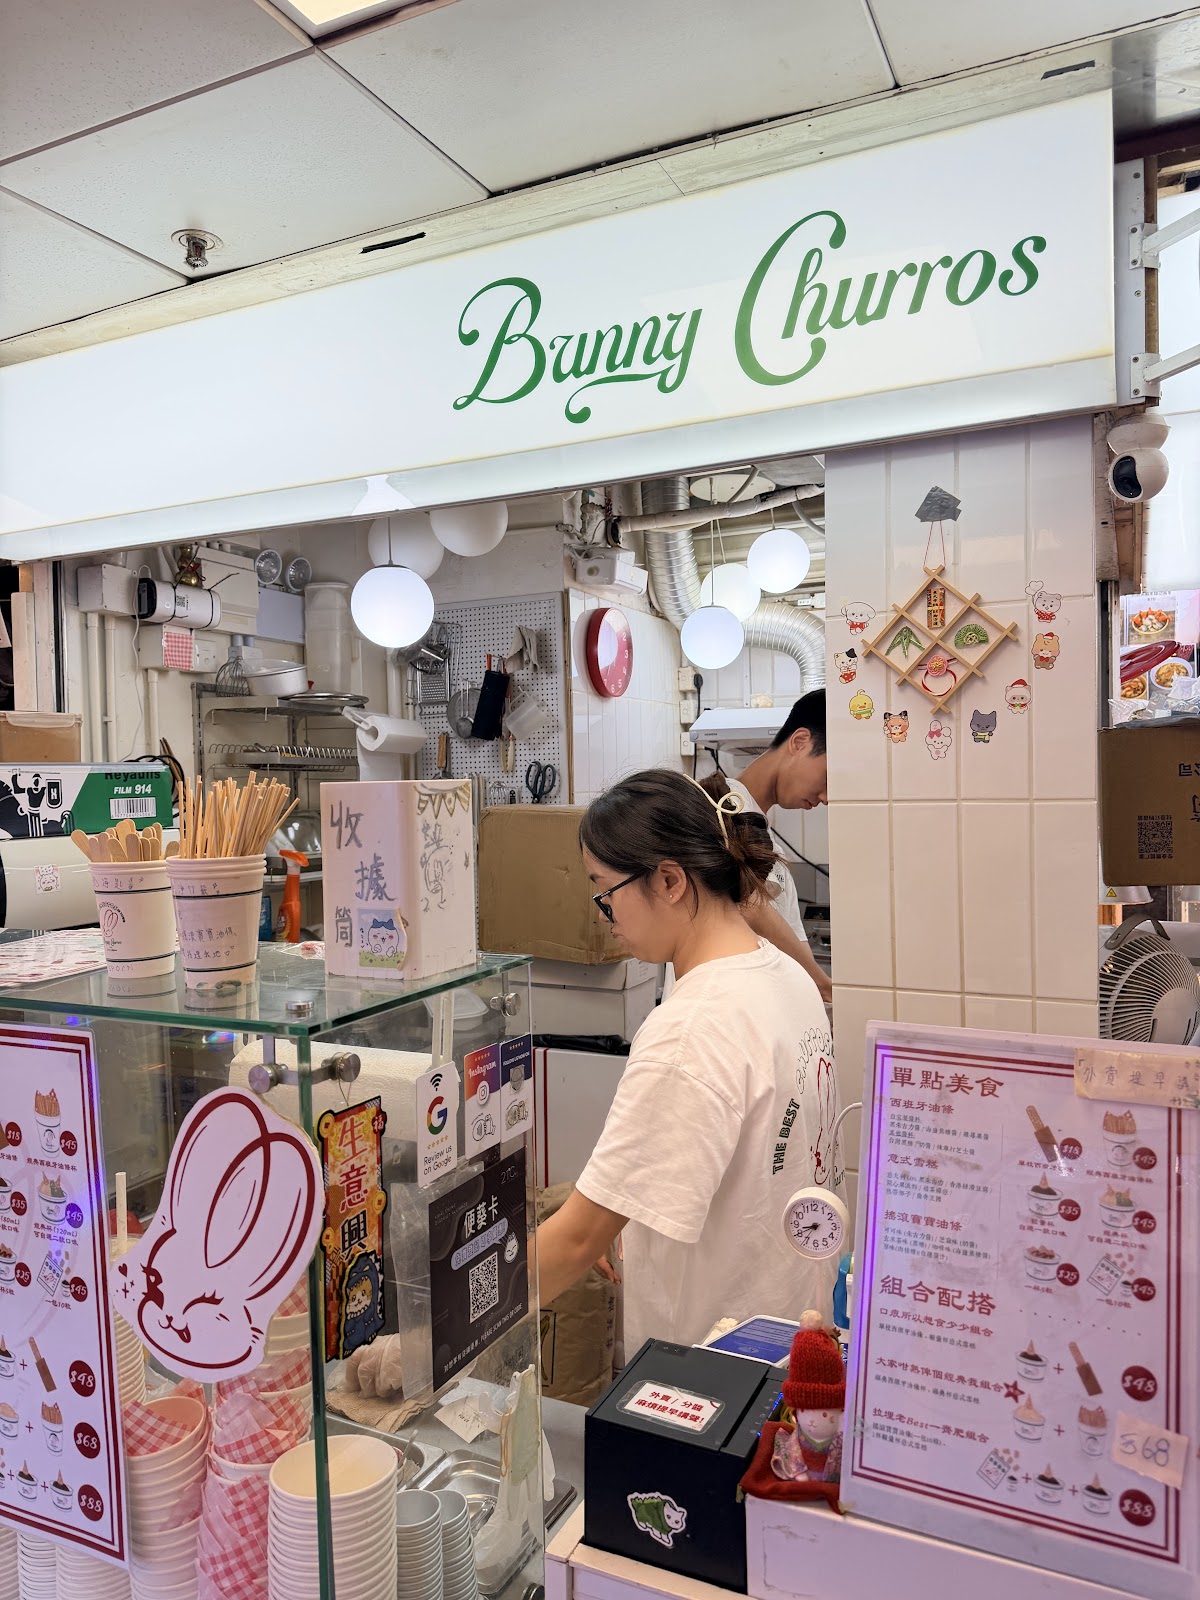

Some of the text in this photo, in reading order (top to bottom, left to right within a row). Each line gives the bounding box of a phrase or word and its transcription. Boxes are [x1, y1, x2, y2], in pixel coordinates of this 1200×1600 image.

[452, 210, 1047, 424] Bunny Churros
[113, 784, 152, 795] FILM 914
[890, 1066, 1004, 1098] 單點美食
[890, 1098, 954, 1115] 西班牙油條
[778, 1097, 801, 1139] BEST
[7, 1129, 20, 1141] $18
[60, 1140, 77, 1151] $45
[1062, 1144, 1080, 1155] $18
[423, 1145, 453, 1167] Review us
[772, 1143, 787, 1176] THE
[887, 1152, 939, 1170] 意式雪糕
[1133, 1153, 1157, 1166] $45
[423, 1155, 452, 1176] on Google
[802, 1205, 809, 1214] 11
[810, 1203, 819, 1212] 12
[821, 1206, 825, 1215] 1
[1059, 1204, 1080, 1216] $35
[65, 1211, 83, 1222] $45
[464, 1195, 499, 1239] 便葵卡
[795, 1211, 804, 1220] 10
[827, 1212, 834, 1221] 2
[884, 1209, 963, 1232] 搖滾寶寶油條
[793, 1220, 800, 1229] 9
[831, 1222, 838, 1231] 3
[1132, 1217, 1156, 1229] $45
[821, 1237, 829, 1247] 5
[828, 1232, 835, 1240] 4
[812, 1239, 819, 1248] 6
[1057, 1268, 1078, 1283] $25
[70, 1284, 87, 1296] $45
[879, 1274, 997, 1316] 組合配搭
[1132, 1284, 1156, 1297] $45
[70, 1369, 95, 1389] $48
[1122, 1374, 1156, 1393] $48
[649, 1391, 672, 1403] 外賣
[634, 1398, 705, 1424] 麻煩提早講聲!
[76, 1431, 98, 1450] $68
[80, 1494, 103, 1513] $88
[1121, 1498, 1154, 1518] $88
